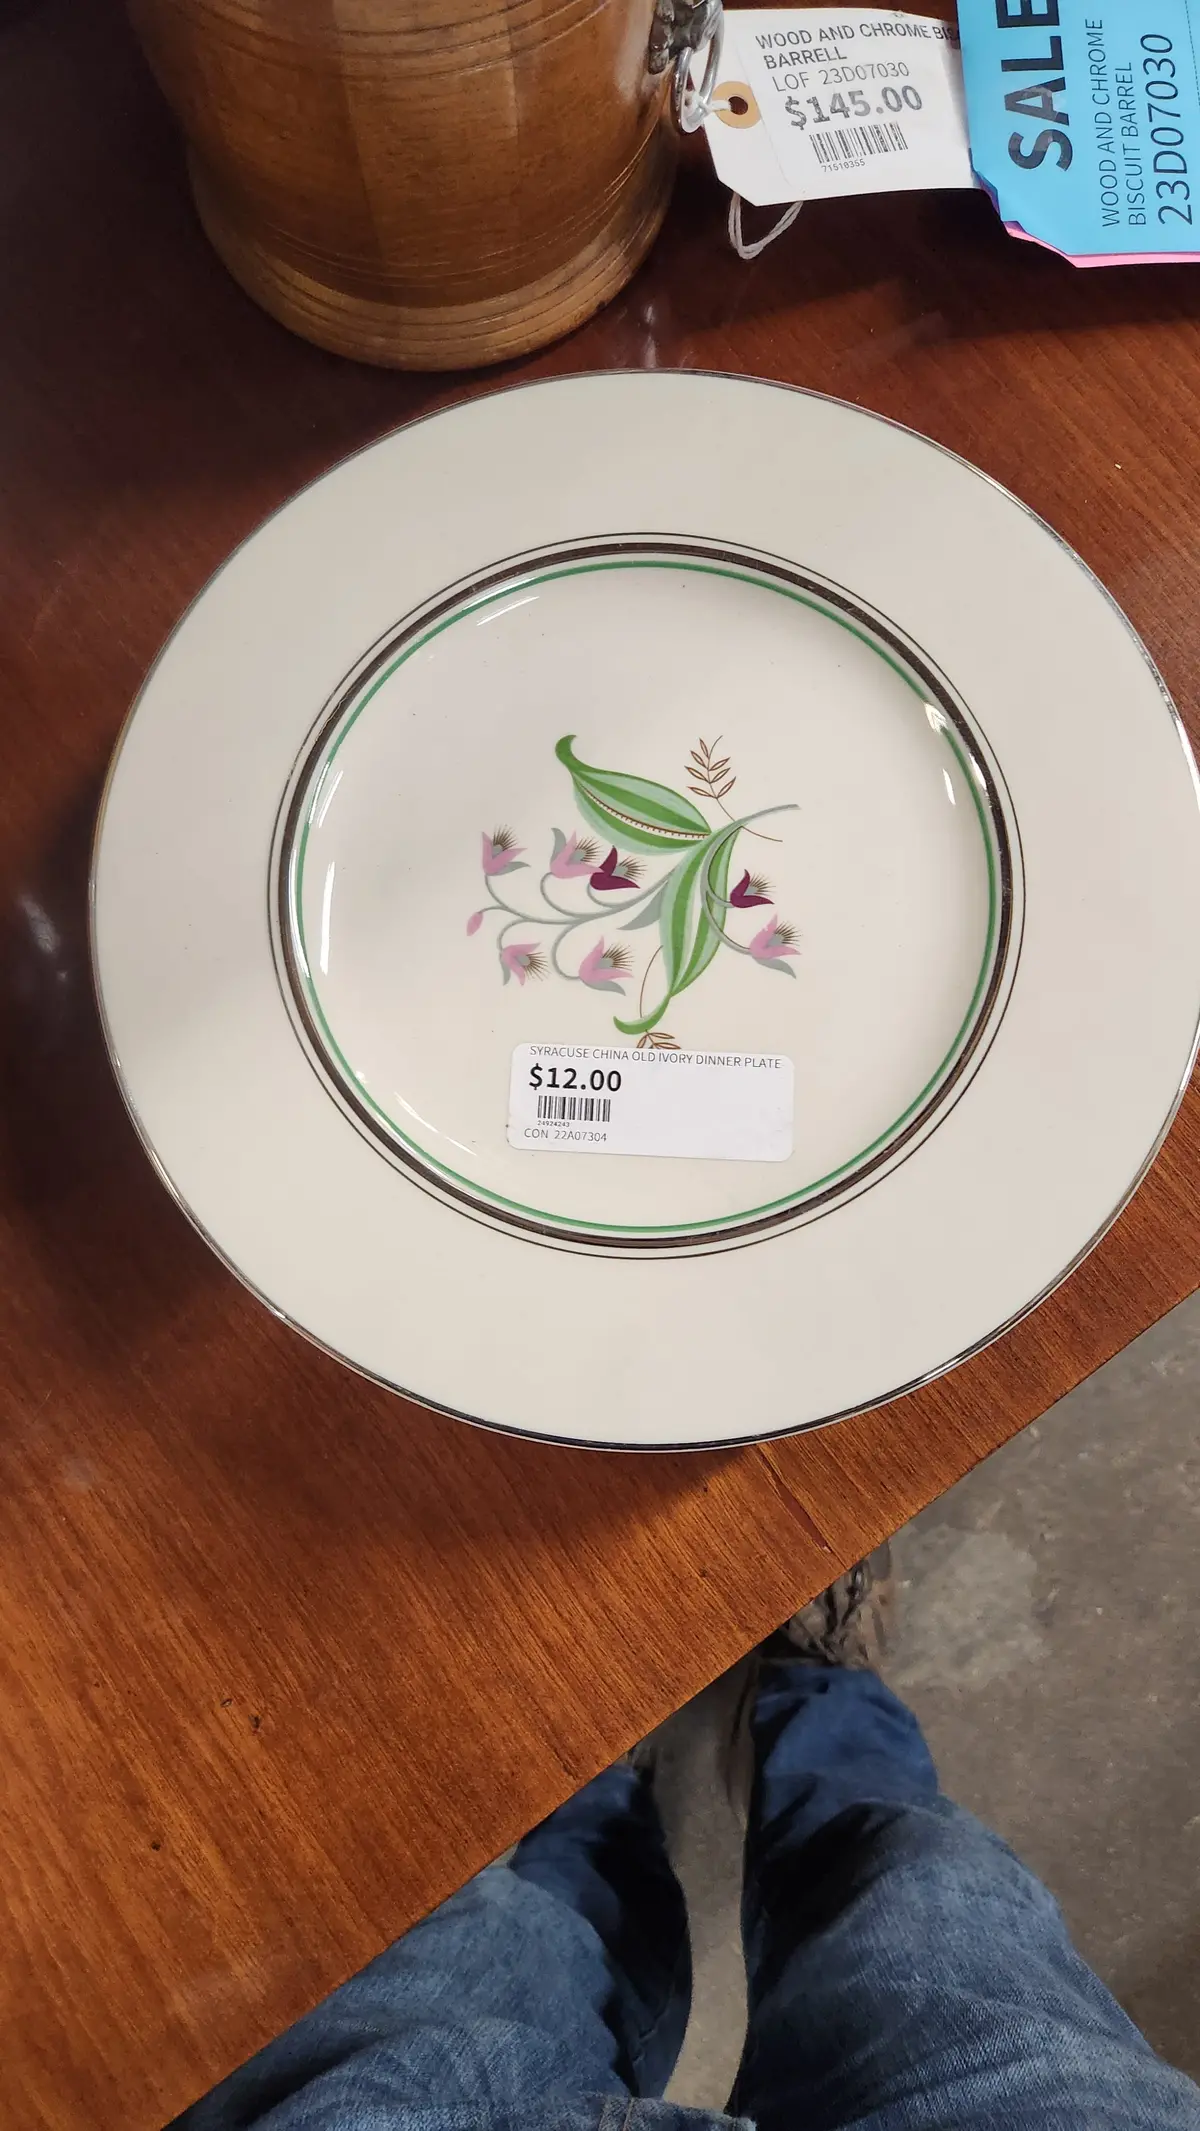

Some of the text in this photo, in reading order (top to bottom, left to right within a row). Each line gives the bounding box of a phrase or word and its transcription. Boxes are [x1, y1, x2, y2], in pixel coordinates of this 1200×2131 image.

[755, 29, 812, 50] WOOD
[818, 25, 855, 42] AND
[859, 22, 932, 39] CHROME
[763, 46, 848, 70] BARRELL
[772, 61, 910, 92] LOF 23D07030
[995, 0, 1073, 172] SALE
[784, 85, 923, 131] $145.00
[1085, 18, 1120, 227] WOOD AND CHROME
[1115, 62, 1146, 226] BISCUIT BARREL
[1140, 33, 1193, 226] 23D07030
[530, 1045, 783, 1069] SYRACUSE CHINA OLD IVORY DINNER PLATE
[529, 1062, 622, 1092] $12.00
[524, 1127, 608, 1142] CON 22A07304
